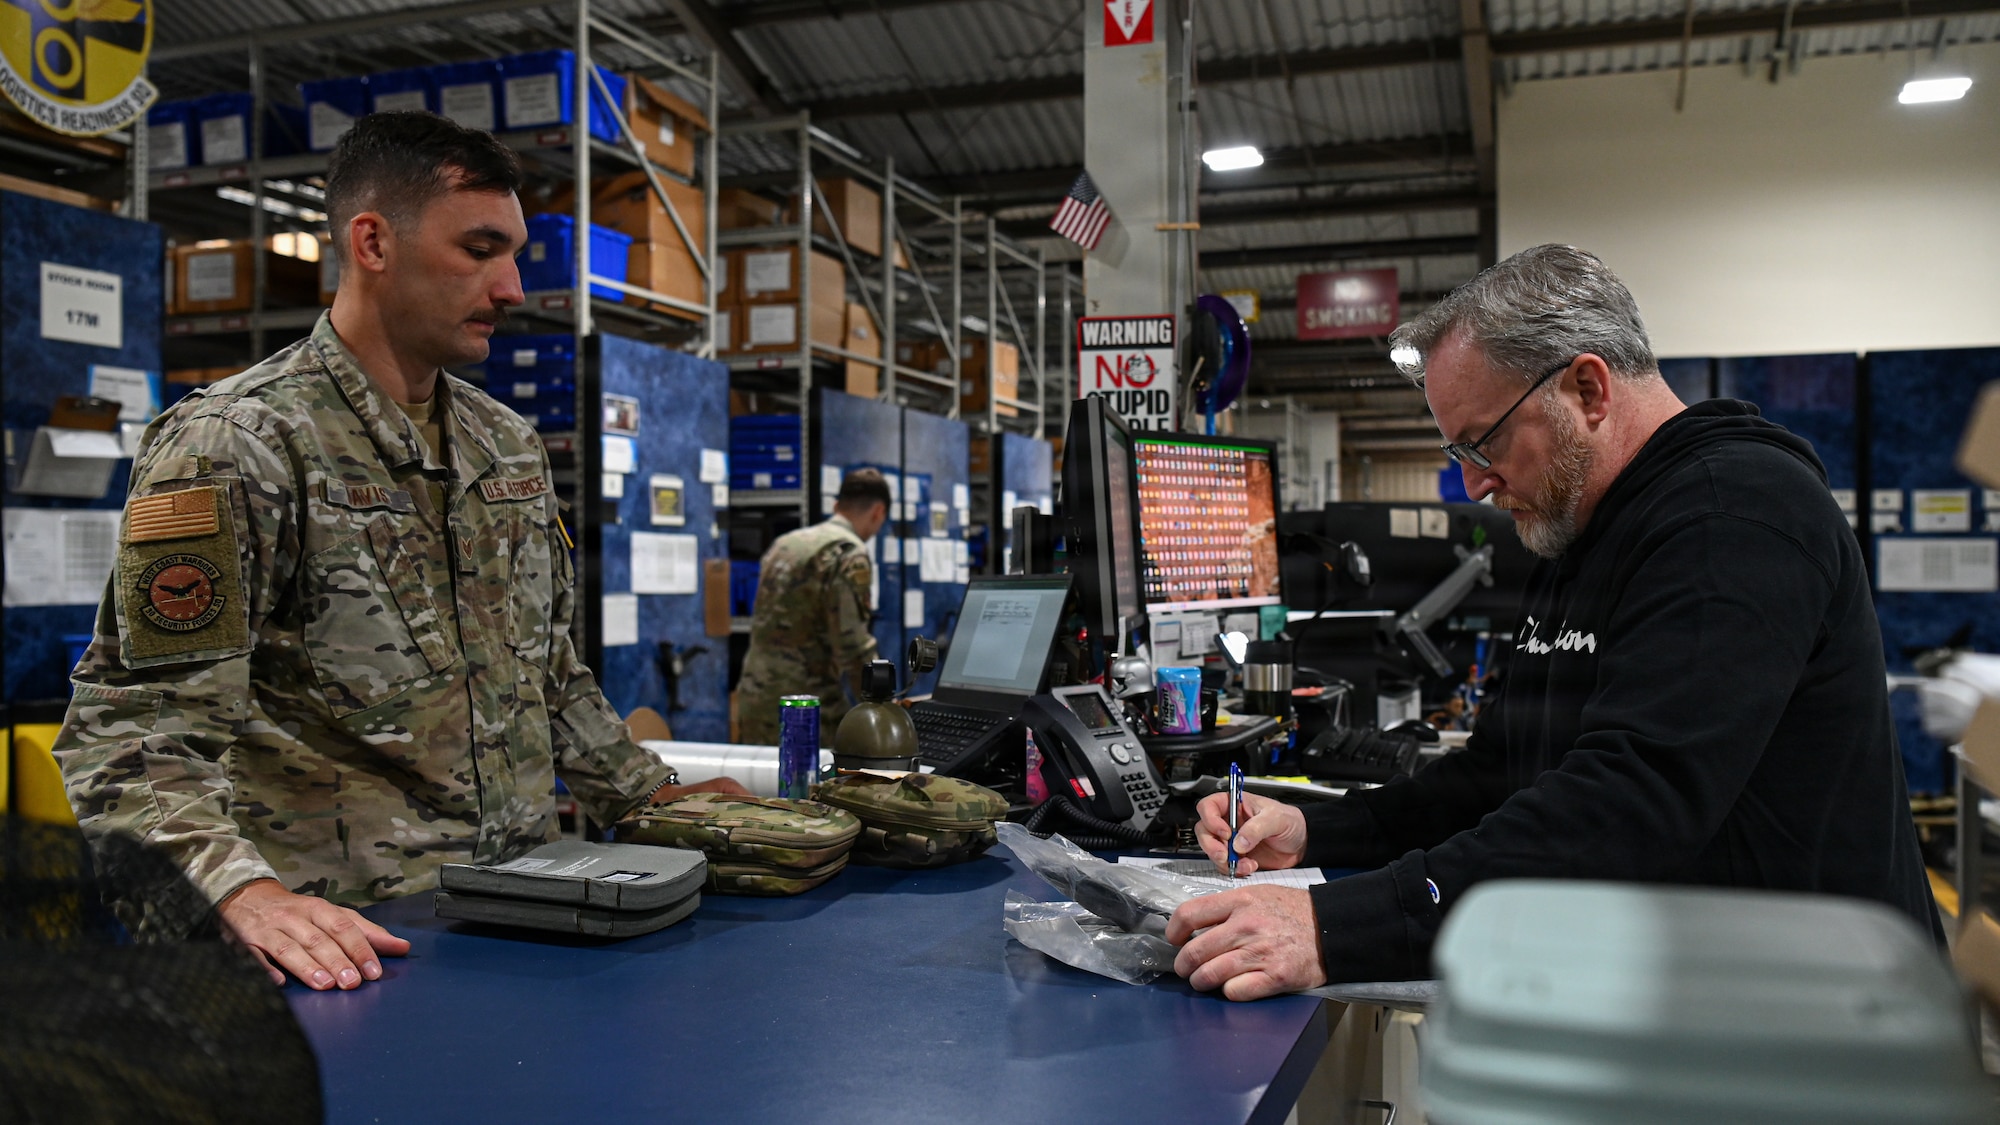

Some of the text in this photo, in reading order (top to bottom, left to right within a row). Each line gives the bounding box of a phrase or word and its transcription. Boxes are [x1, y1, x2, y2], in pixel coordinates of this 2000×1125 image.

[0, 57, 57, 124] OGISTICS
[47, 271, 82, 287] STOCK
[65, 309, 100, 327] 17M
[1305, 303, 1392, 329] SMOKING
[1082, 319, 1172, 346] WARNING
[1096, 353, 1156, 388] NO
[483, 481, 507, 499] U.S.
[141, 555, 217, 585] WEST COAST WARRIORS
[154, 615, 191, 630] SECURITY
[191, 608, 217, 628] FORCES
